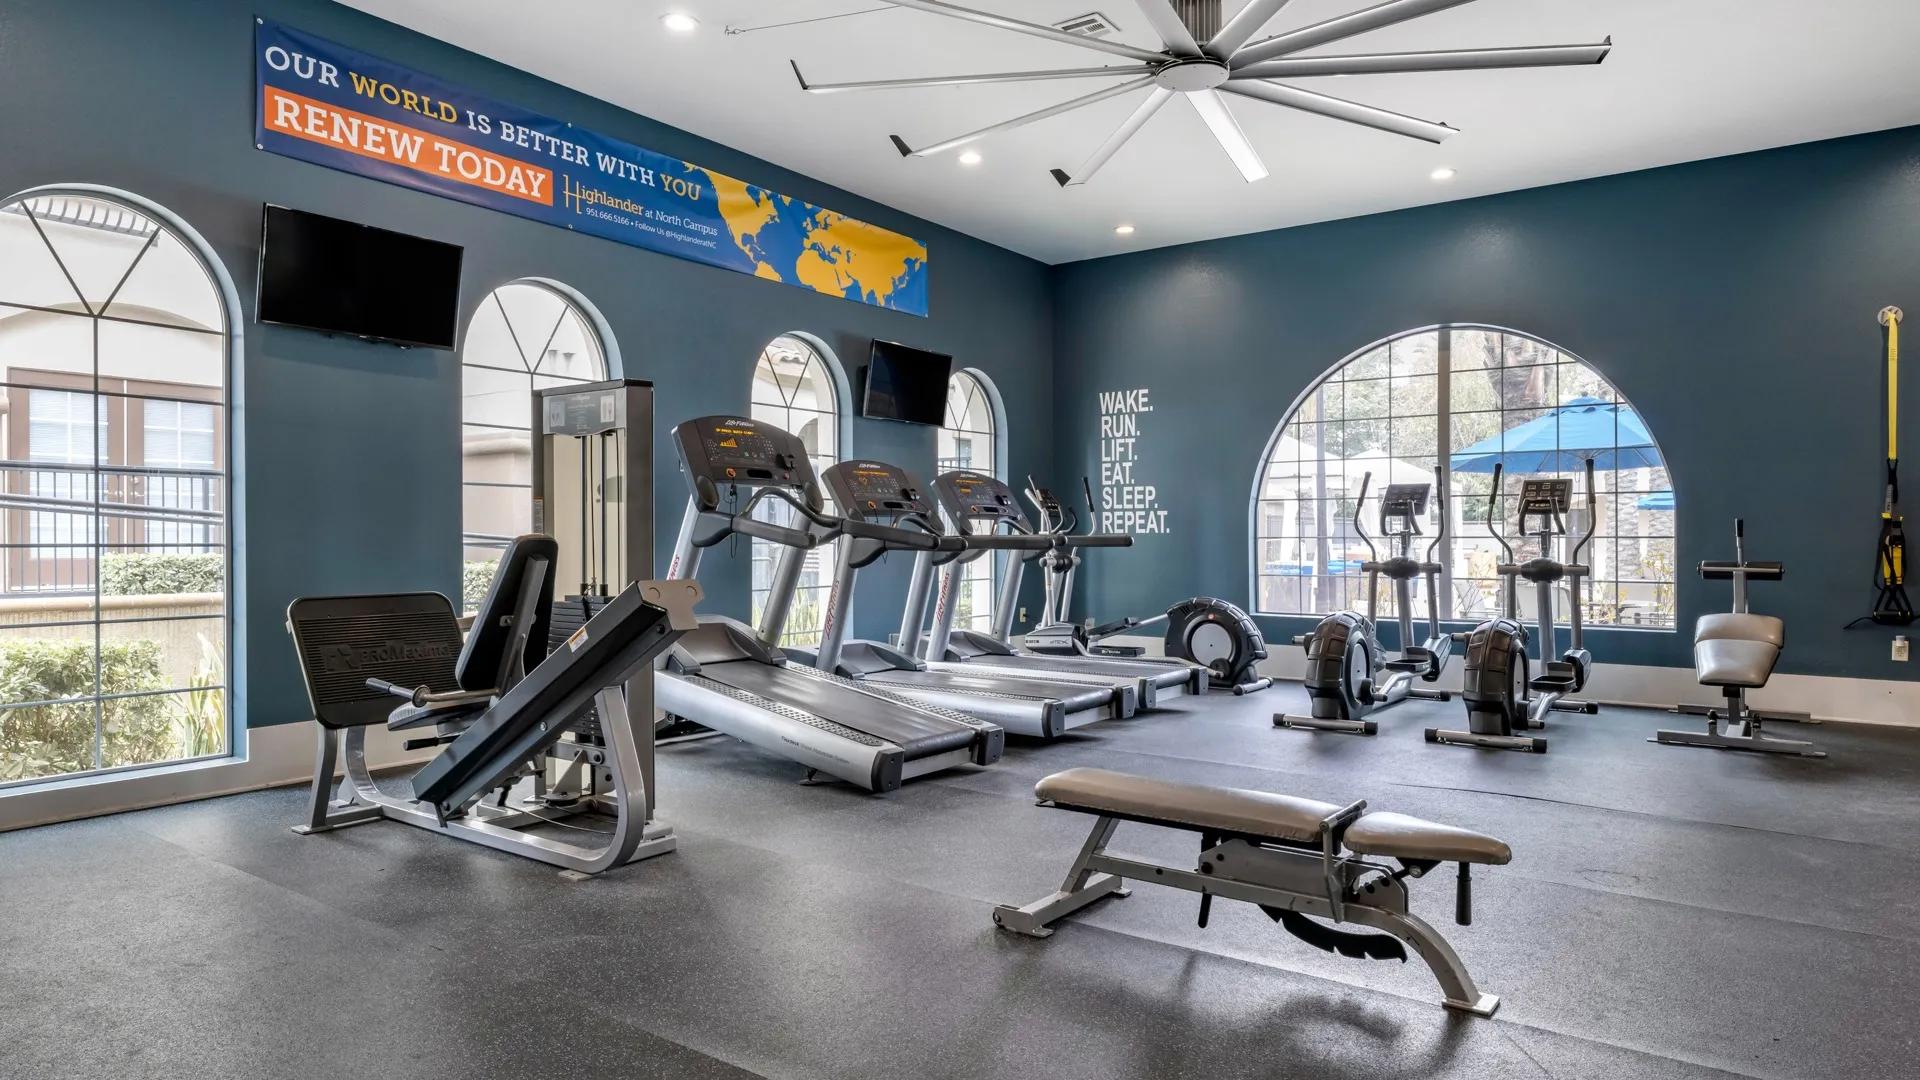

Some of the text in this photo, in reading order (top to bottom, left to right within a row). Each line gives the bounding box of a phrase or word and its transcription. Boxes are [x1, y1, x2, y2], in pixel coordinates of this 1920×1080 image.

[265, 46, 701, 201] OUR WORLD IS BETTER WITH YOU
[273, 95, 546, 198] RENEW TODAY
[563, 174, 718, 236] Highlander at North Campus
[585, 207, 717, 249] 951.666.5166 Follow Us @HighlanderatNC
[1099, 389, 1154, 415] WAKE.
[1101, 414, 1141, 438] RUN.
[1101, 438, 1138, 462] LIFT.
[1101, 462, 1135, 485] EAT.
[1102, 486, 1158, 510] SLEEP.
[1102, 510, 1170, 534] REPEAT.
